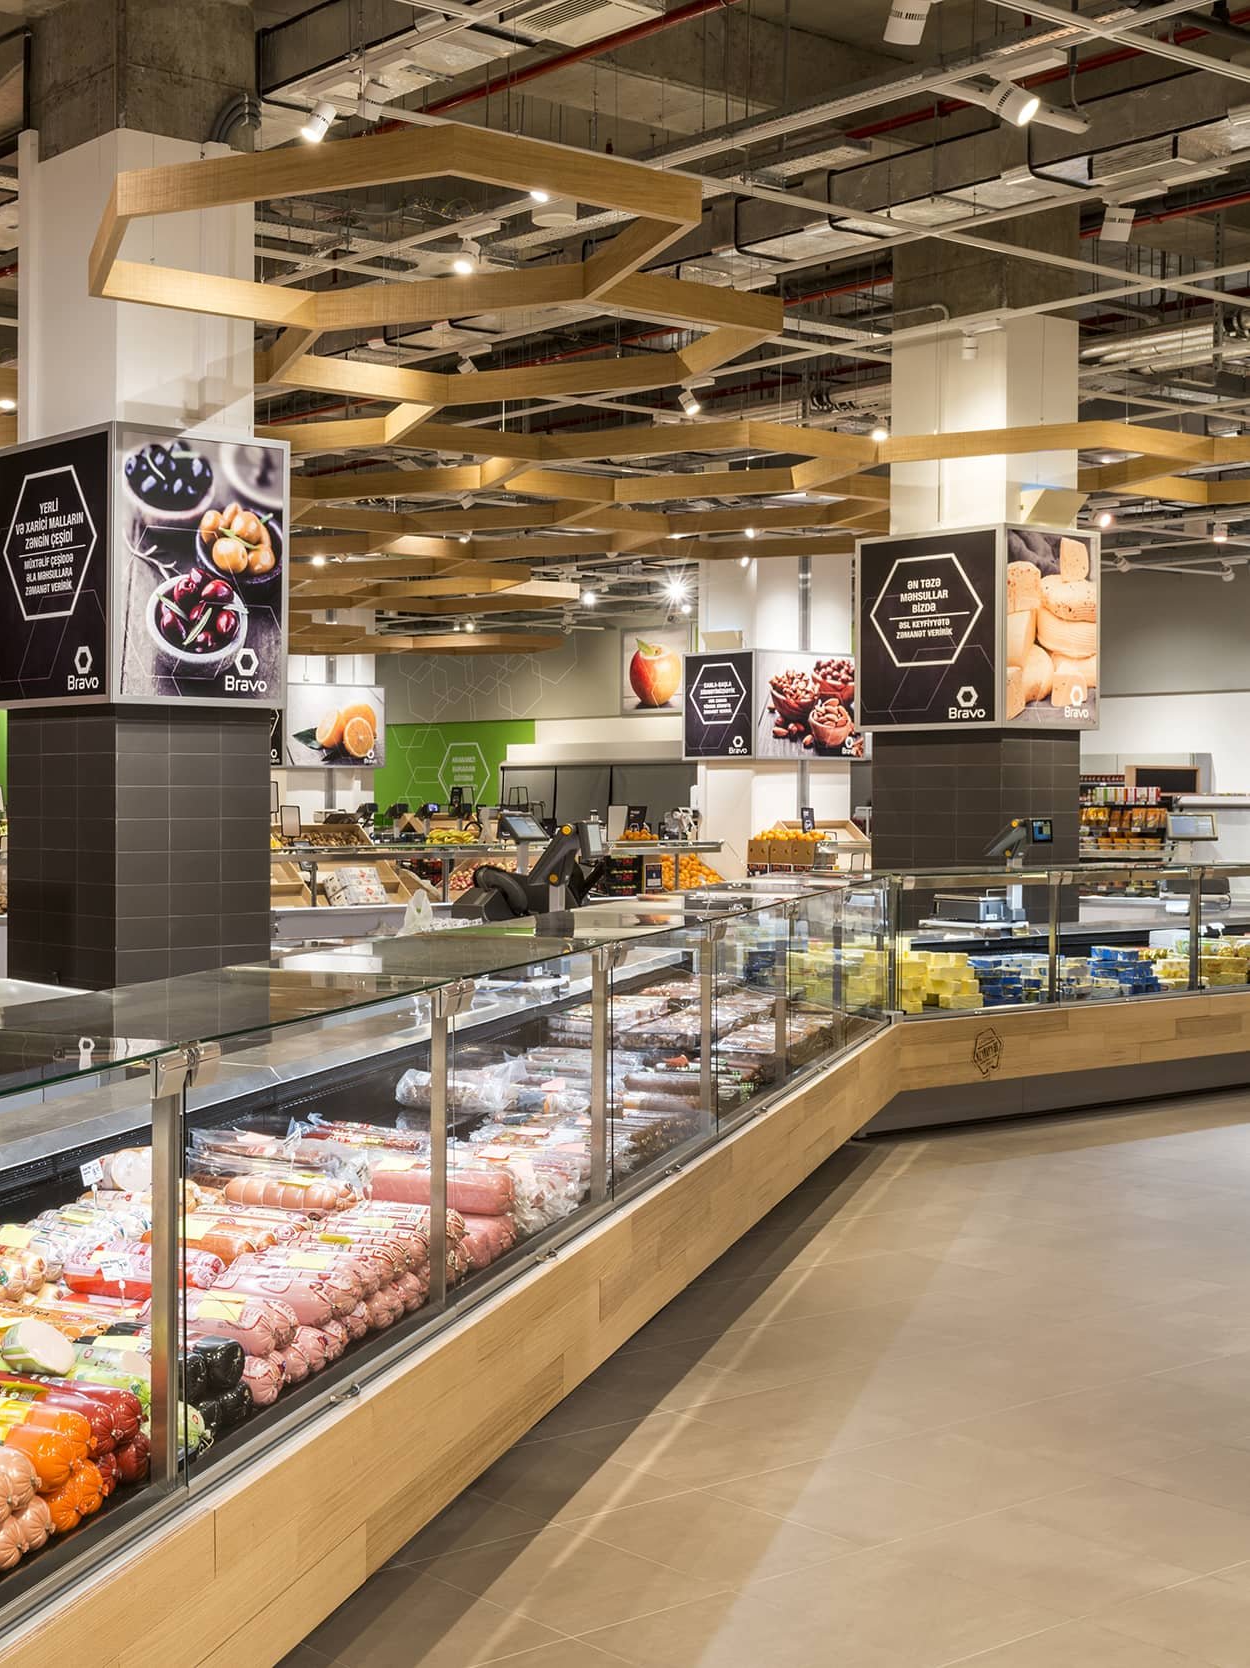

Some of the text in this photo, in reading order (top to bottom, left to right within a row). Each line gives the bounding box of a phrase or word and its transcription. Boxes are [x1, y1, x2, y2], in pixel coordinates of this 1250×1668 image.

[39, 497, 59, 515] YERLİ
[15, 511, 84, 535] VƏ XARİCİ MALLARIN
[25, 532, 50, 550] ZƏNGİN
[907, 577, 942, 590] ƏN TƏZƏ
[900, 589, 949, 603] MƏHSULLAR
[912, 602, 936, 614] BİZDƏ
[67, 675, 99, 691] Bravo
[224, 675, 267, 693] Bravo
[948, 707, 986, 720] Bravo
[1064, 706, 1089, 719] Bravo
[728, 746, 748, 755] Bravo
